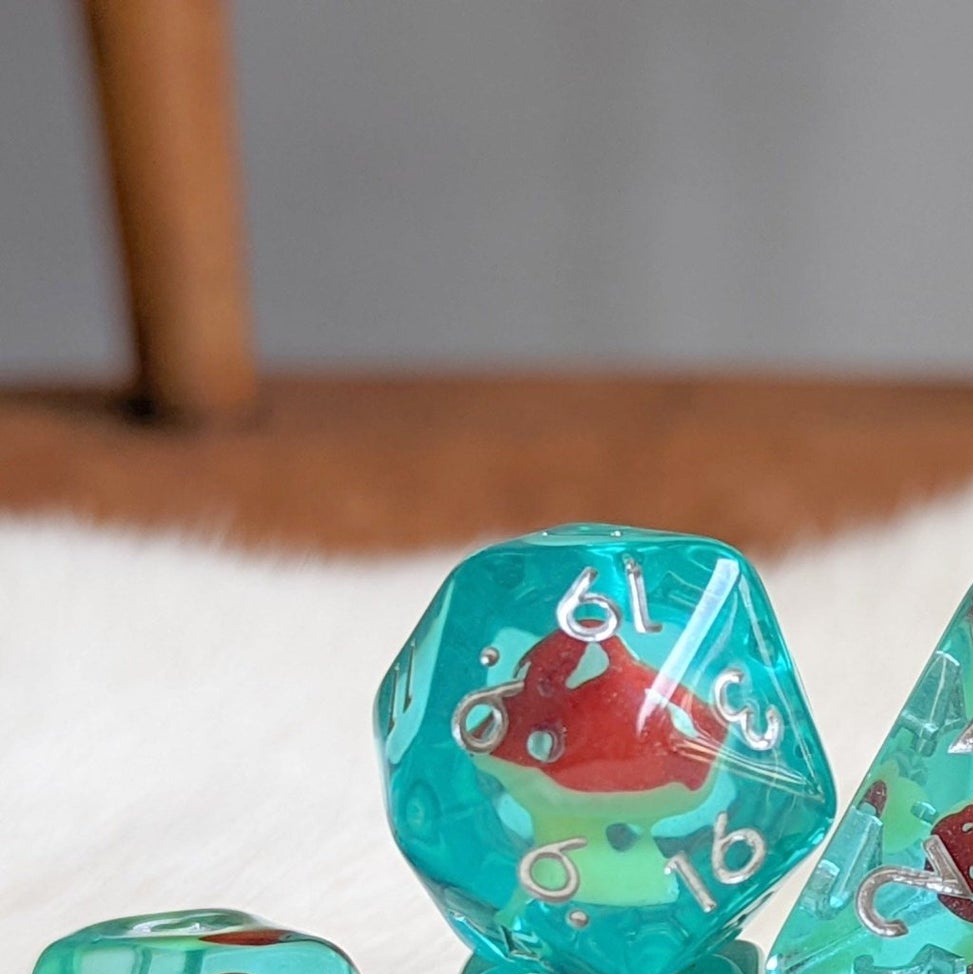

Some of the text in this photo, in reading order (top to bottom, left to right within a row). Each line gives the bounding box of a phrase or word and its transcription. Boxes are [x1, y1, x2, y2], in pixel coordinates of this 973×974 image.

[556, 556, 662, 641] 19
[713, 668, 781, 750] 3
[664, 812, 766, 912] 16
